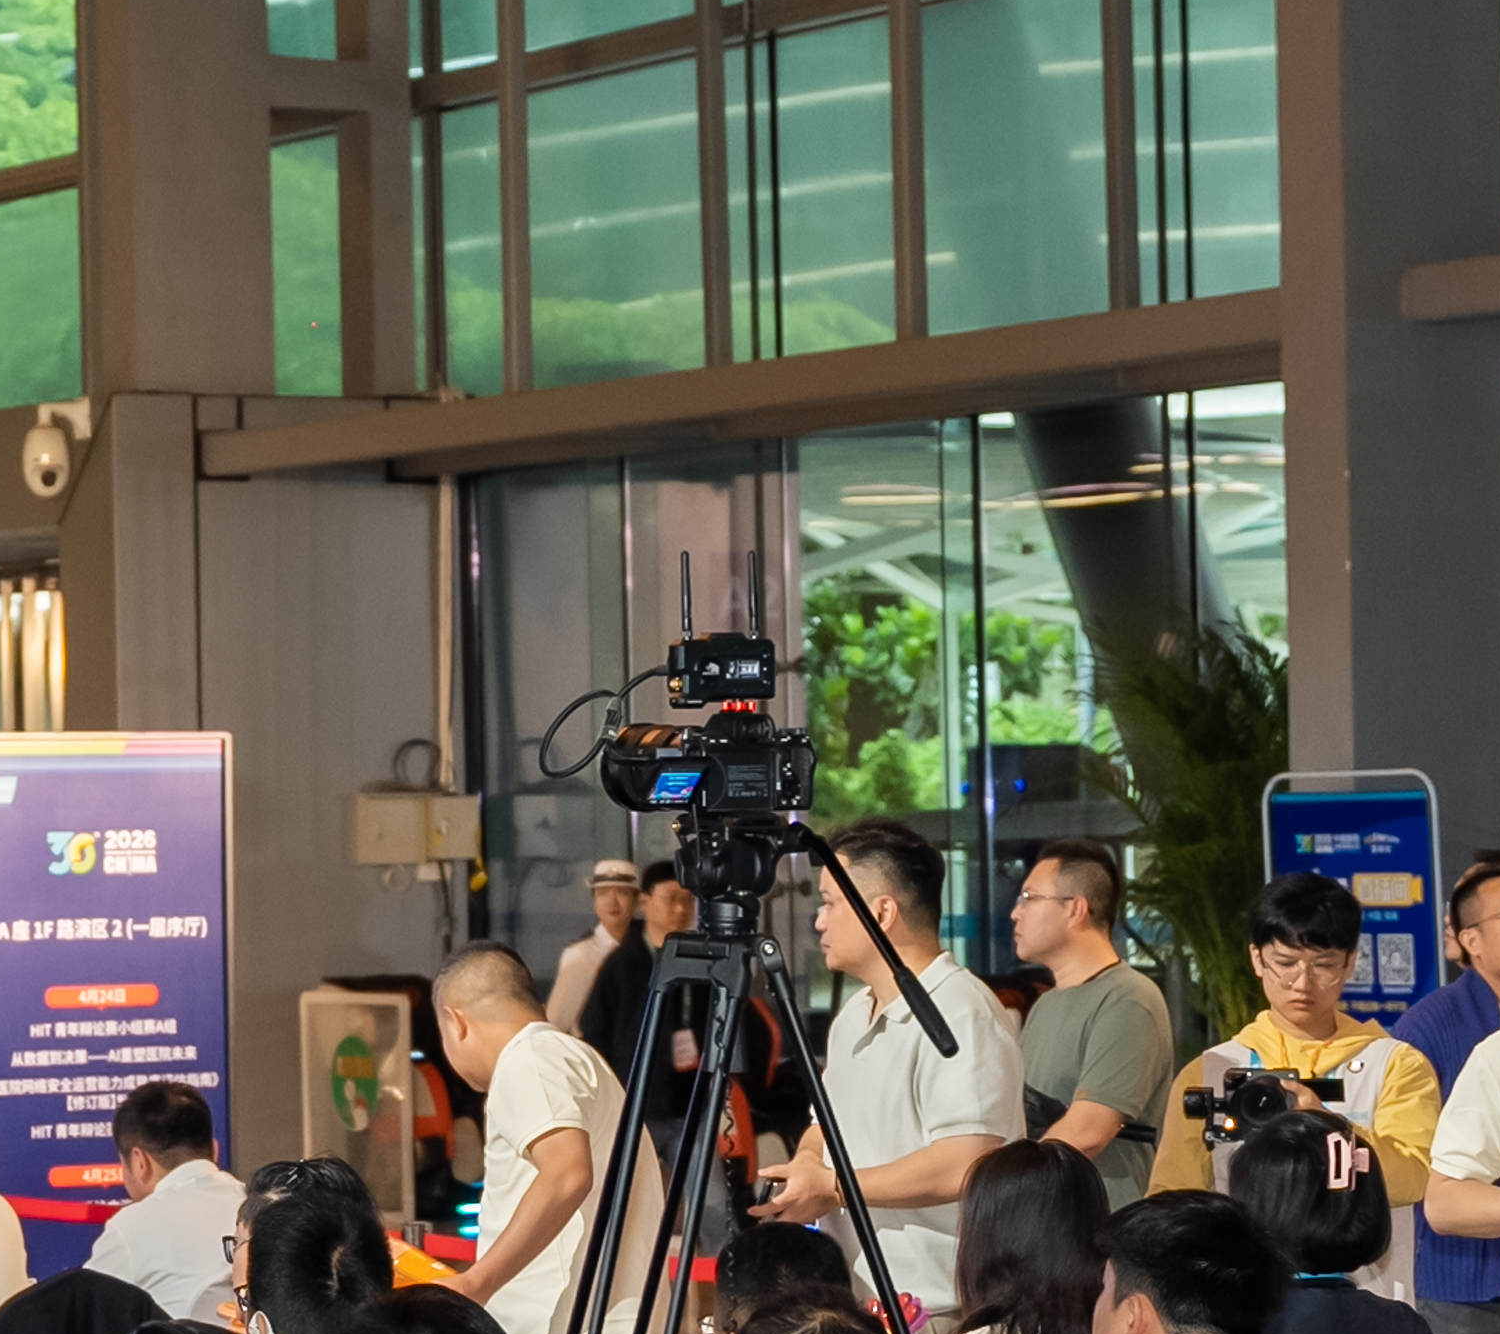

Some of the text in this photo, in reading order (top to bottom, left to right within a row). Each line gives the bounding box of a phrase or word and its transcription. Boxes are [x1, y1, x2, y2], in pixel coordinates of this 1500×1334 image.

[104, 829, 157, 850] 2026
[78, 987, 127, 1004] 4月24日
[82, 1167, 124, 1184] 4月25
